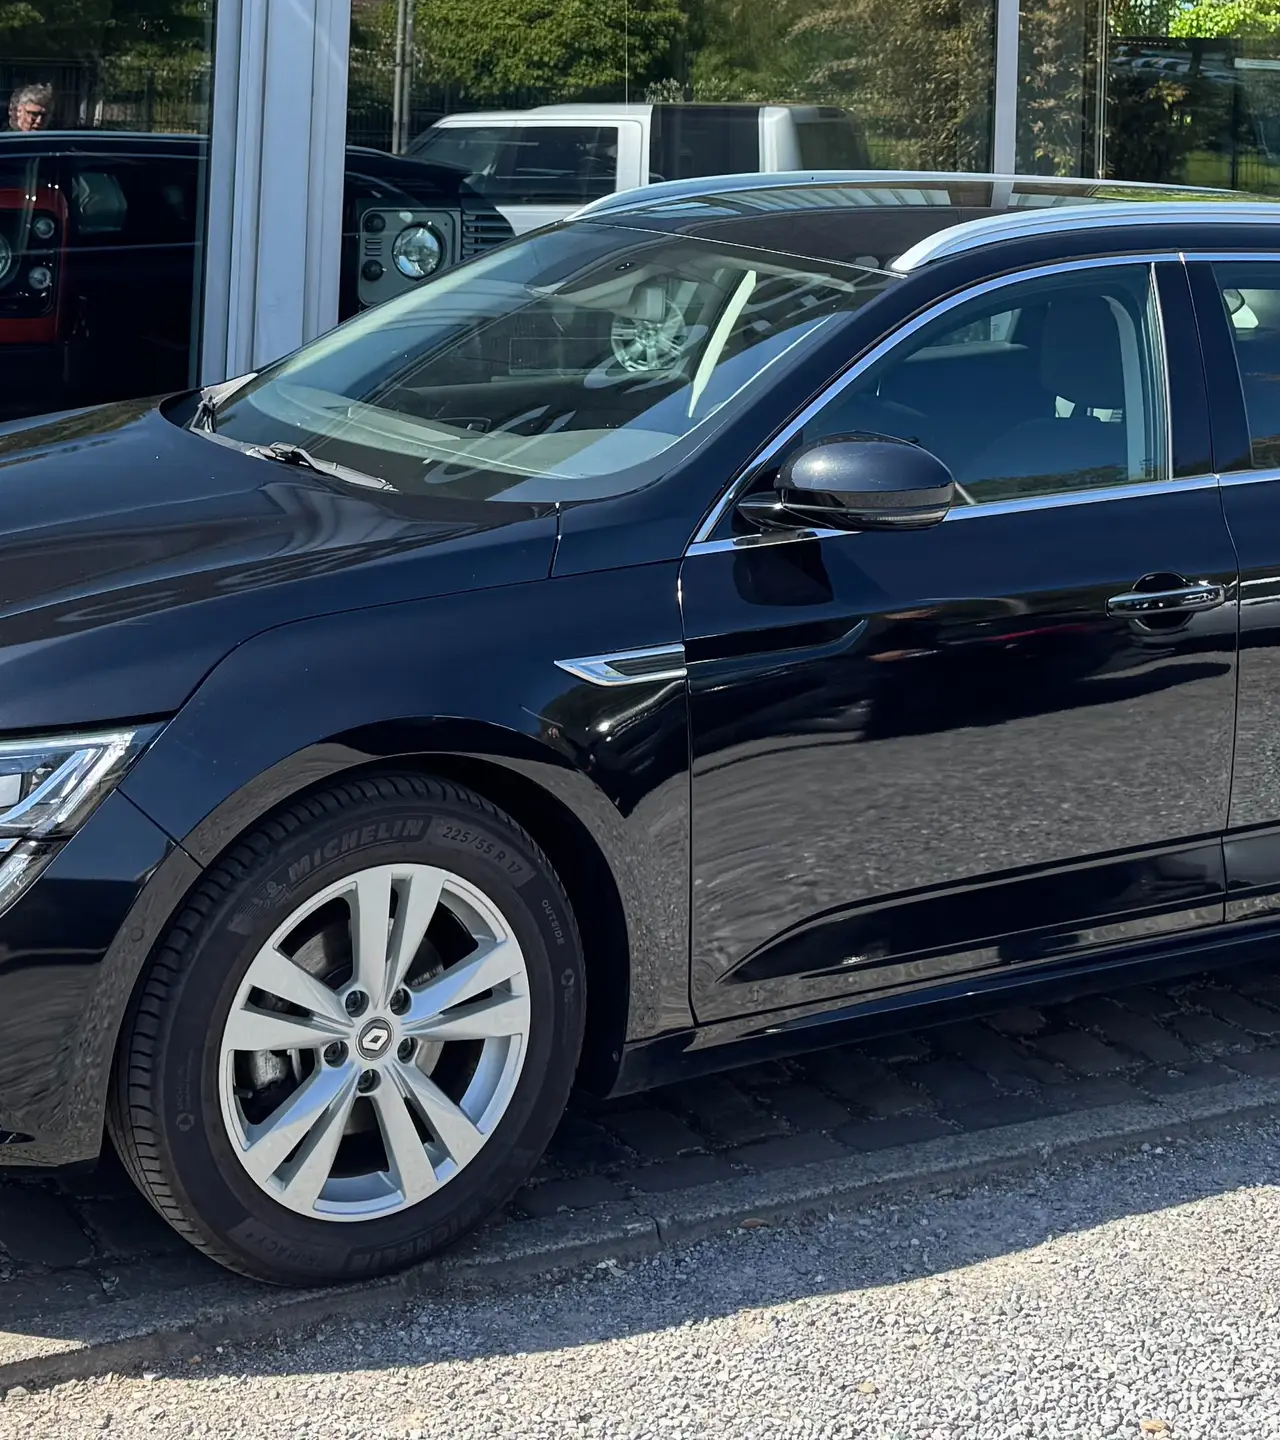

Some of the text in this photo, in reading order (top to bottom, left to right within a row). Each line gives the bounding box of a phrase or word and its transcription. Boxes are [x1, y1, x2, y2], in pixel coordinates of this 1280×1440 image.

[287, 818, 425, 881] MICHELIN
[441, 825, 495, 855] 225/55
[505, 858, 523, 876] 17
[540, 898, 566, 947] OUTSIDE
